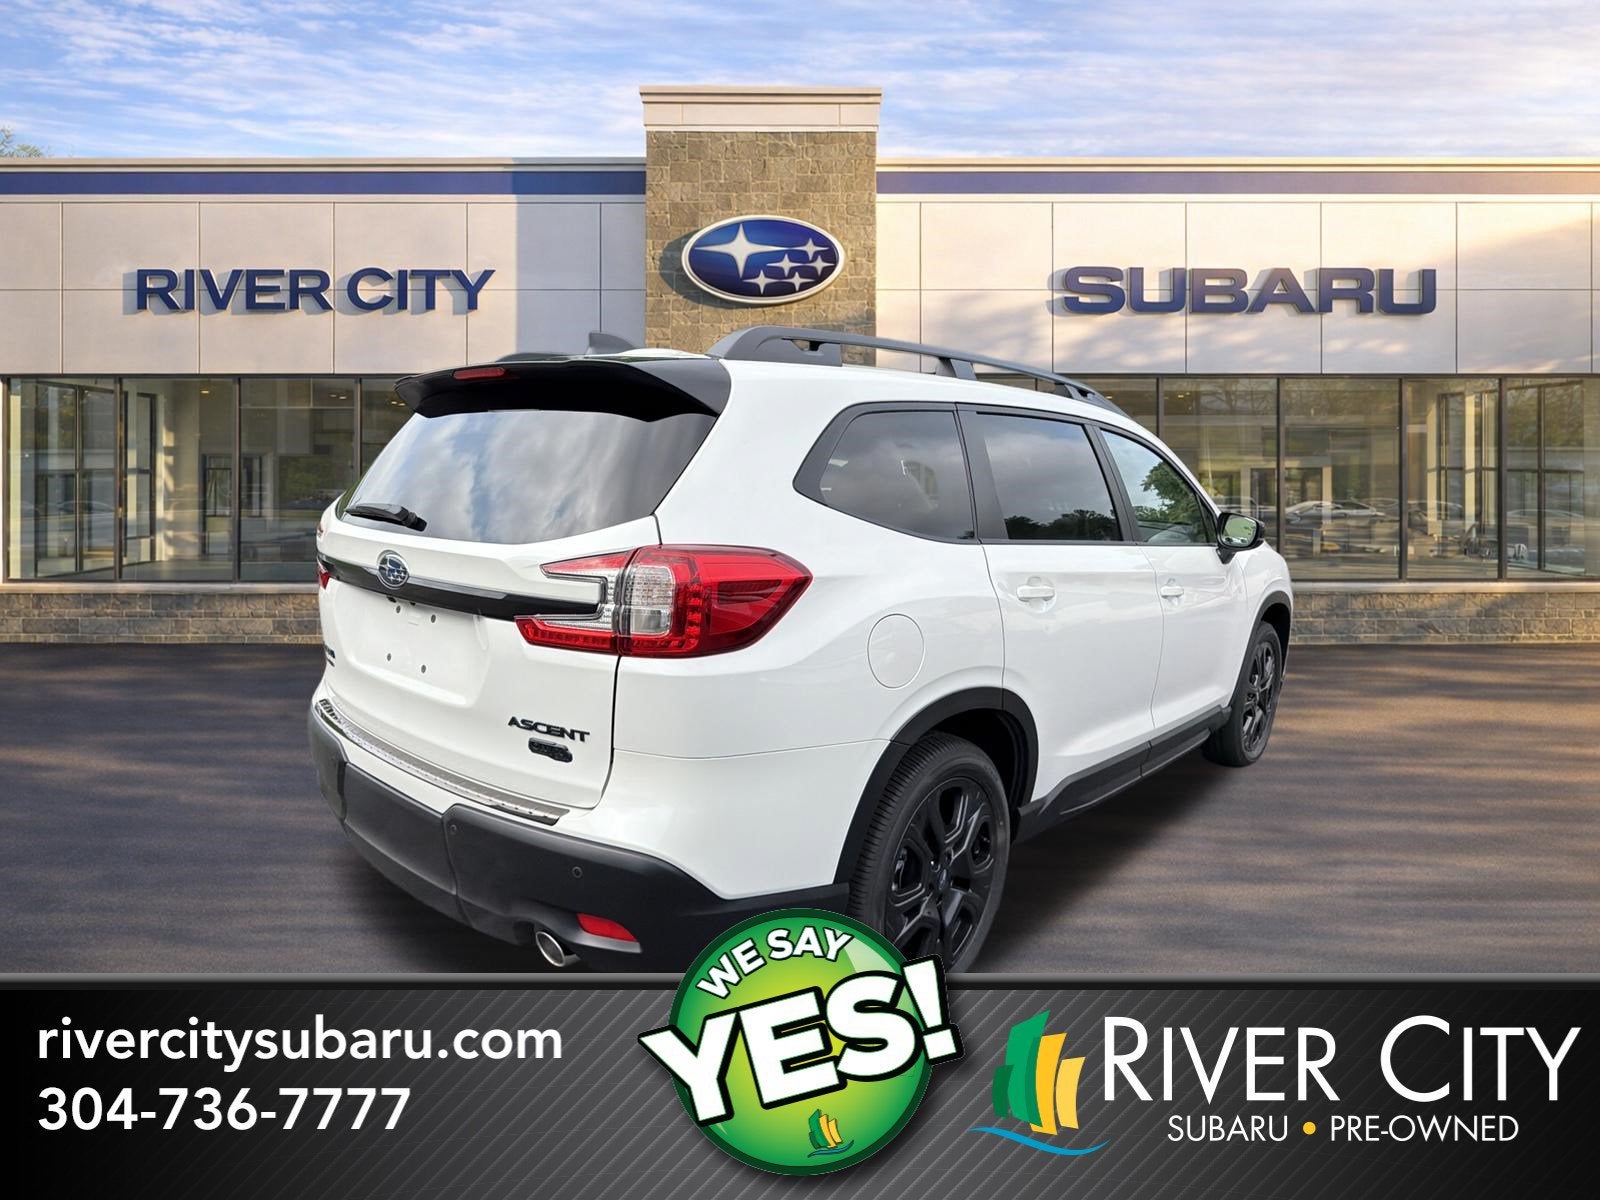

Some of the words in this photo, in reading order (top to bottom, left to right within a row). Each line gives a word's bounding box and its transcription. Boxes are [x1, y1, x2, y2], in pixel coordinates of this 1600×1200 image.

[136, 268, 333, 311] RIVER
[346, 267, 495, 311] CITY
[1063, 266, 1437, 314] SUBARU
[508, 716, 590, 742] ASCENT
